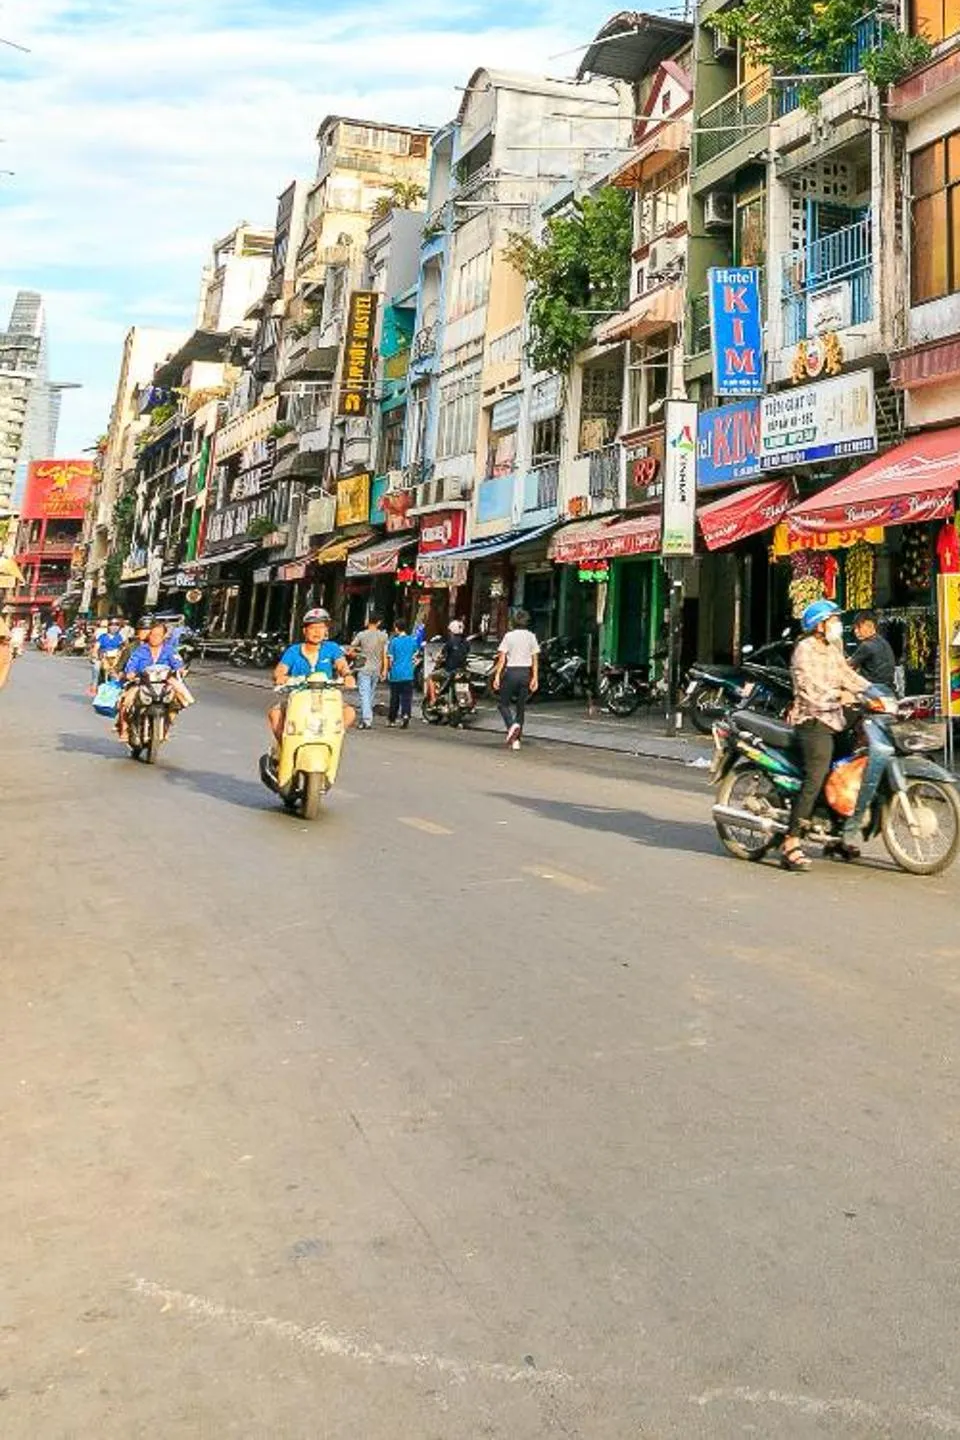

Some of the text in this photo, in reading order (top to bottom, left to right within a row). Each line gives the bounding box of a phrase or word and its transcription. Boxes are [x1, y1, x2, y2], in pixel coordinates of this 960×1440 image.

[716, 269, 753, 285] Hotel
[353, 295, 372, 338] HOSTEL
[723, 286, 757, 376] KIM
